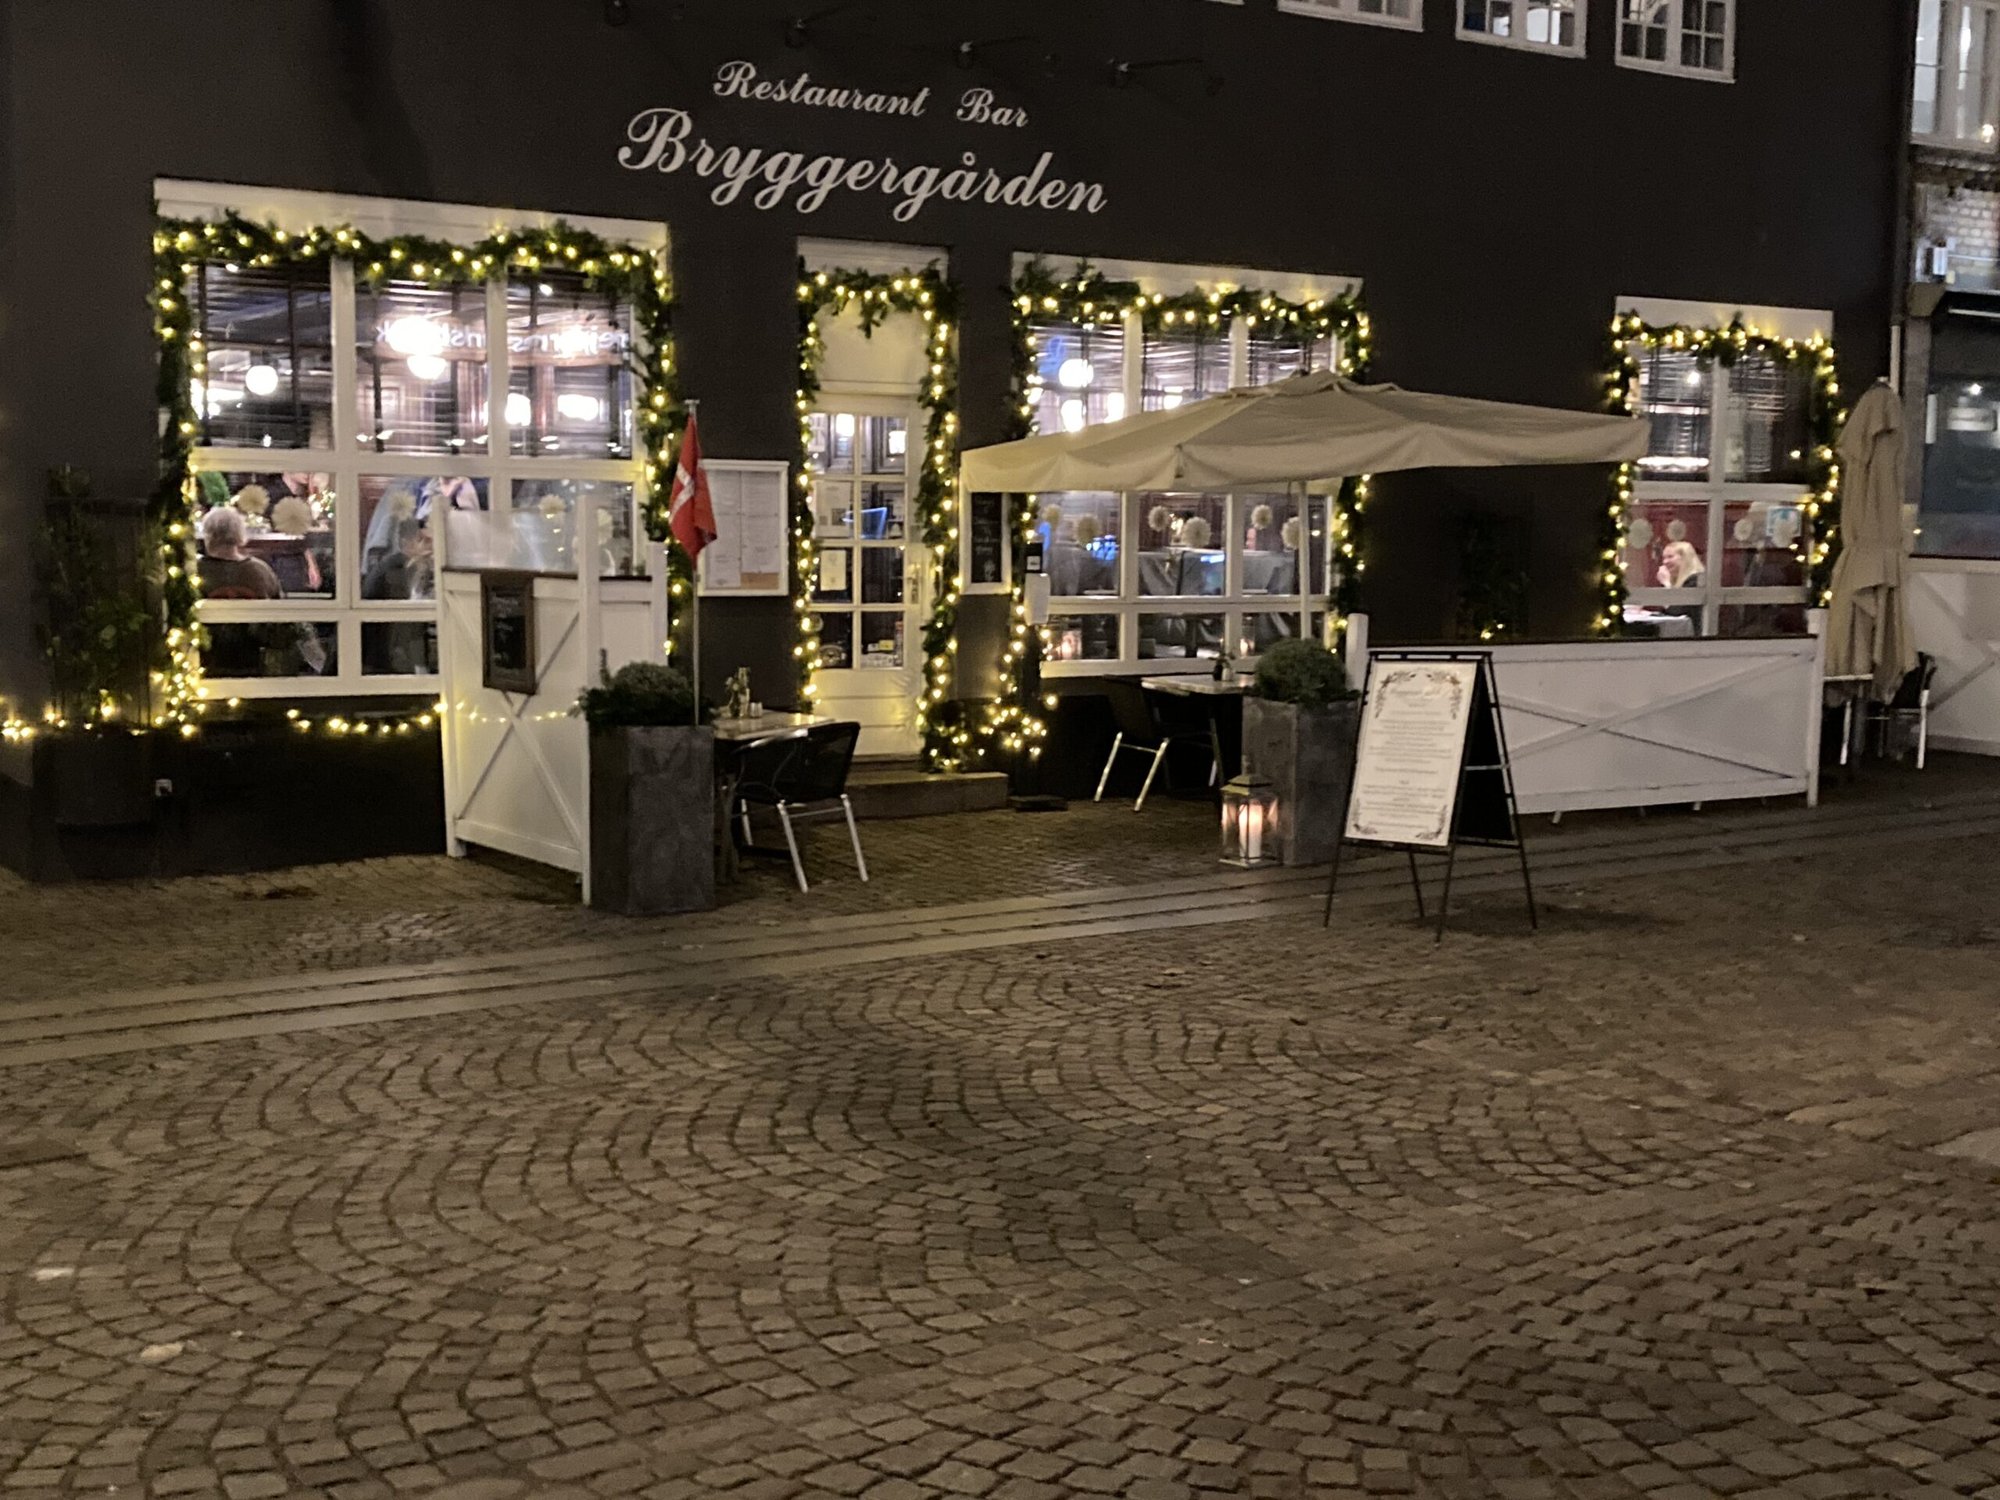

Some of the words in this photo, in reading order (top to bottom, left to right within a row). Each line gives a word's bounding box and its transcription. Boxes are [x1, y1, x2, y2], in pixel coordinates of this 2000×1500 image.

[713, 60, 930, 117] Restaurant
[956, 87, 1029, 128] Bar
[617, 107, 1108, 222] Bryggergården
